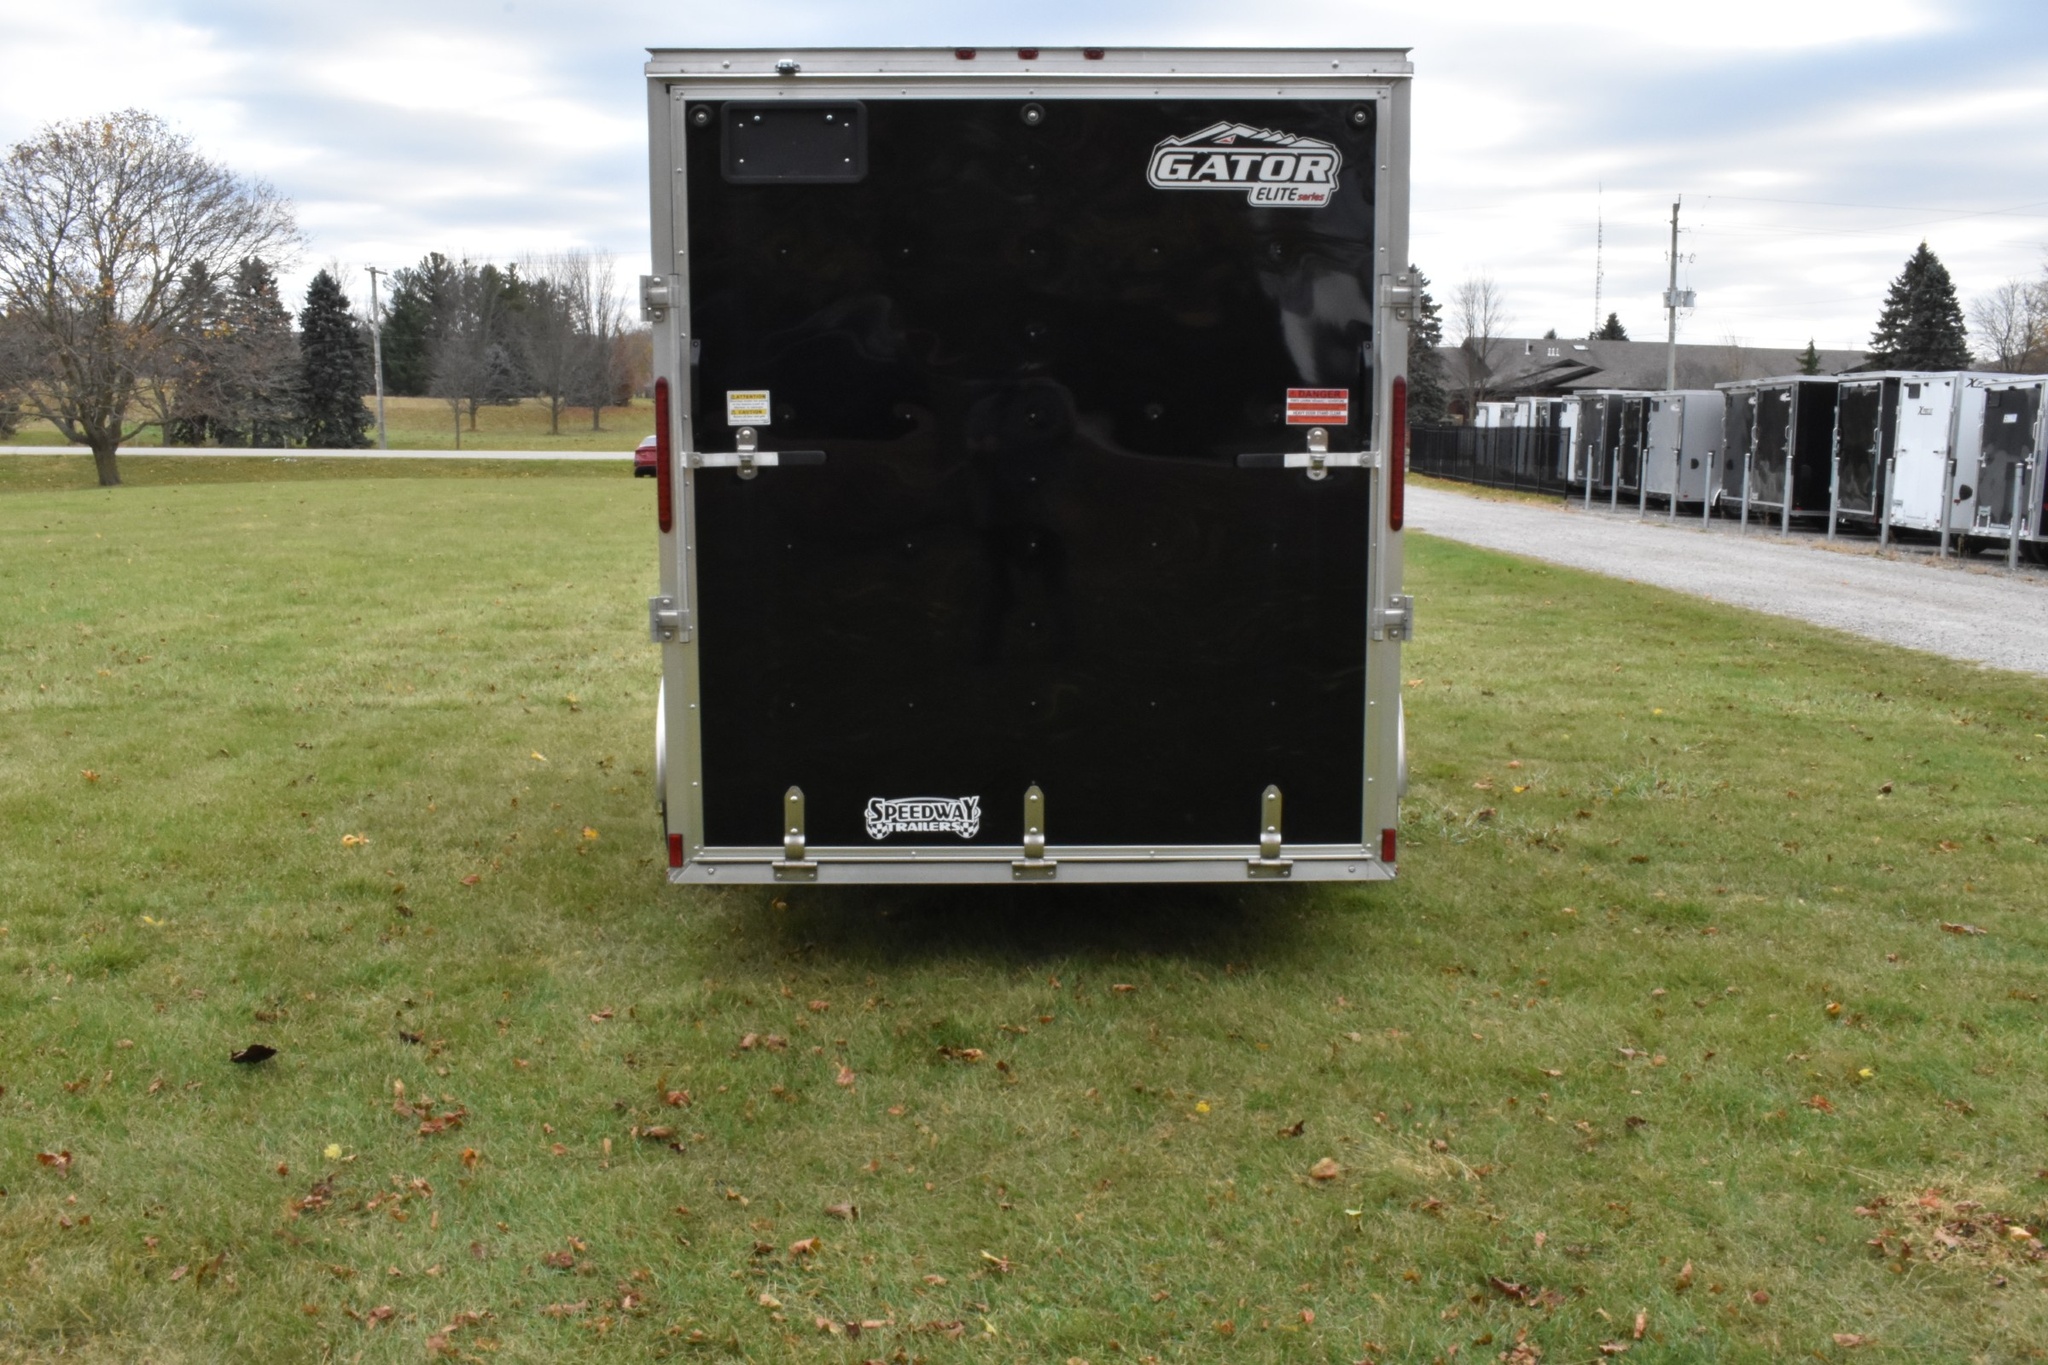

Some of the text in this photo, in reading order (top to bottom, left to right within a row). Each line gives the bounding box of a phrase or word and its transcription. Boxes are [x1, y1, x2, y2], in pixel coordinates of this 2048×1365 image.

[1156, 153, 1332, 182] GATOR
[1256, 187, 1325, 201] ELITE series
[1299, 390, 1340, 398] DANGER
[868, 795, 980, 824] SPEEDWAY
[886, 822, 960, 831] TRAILERS
